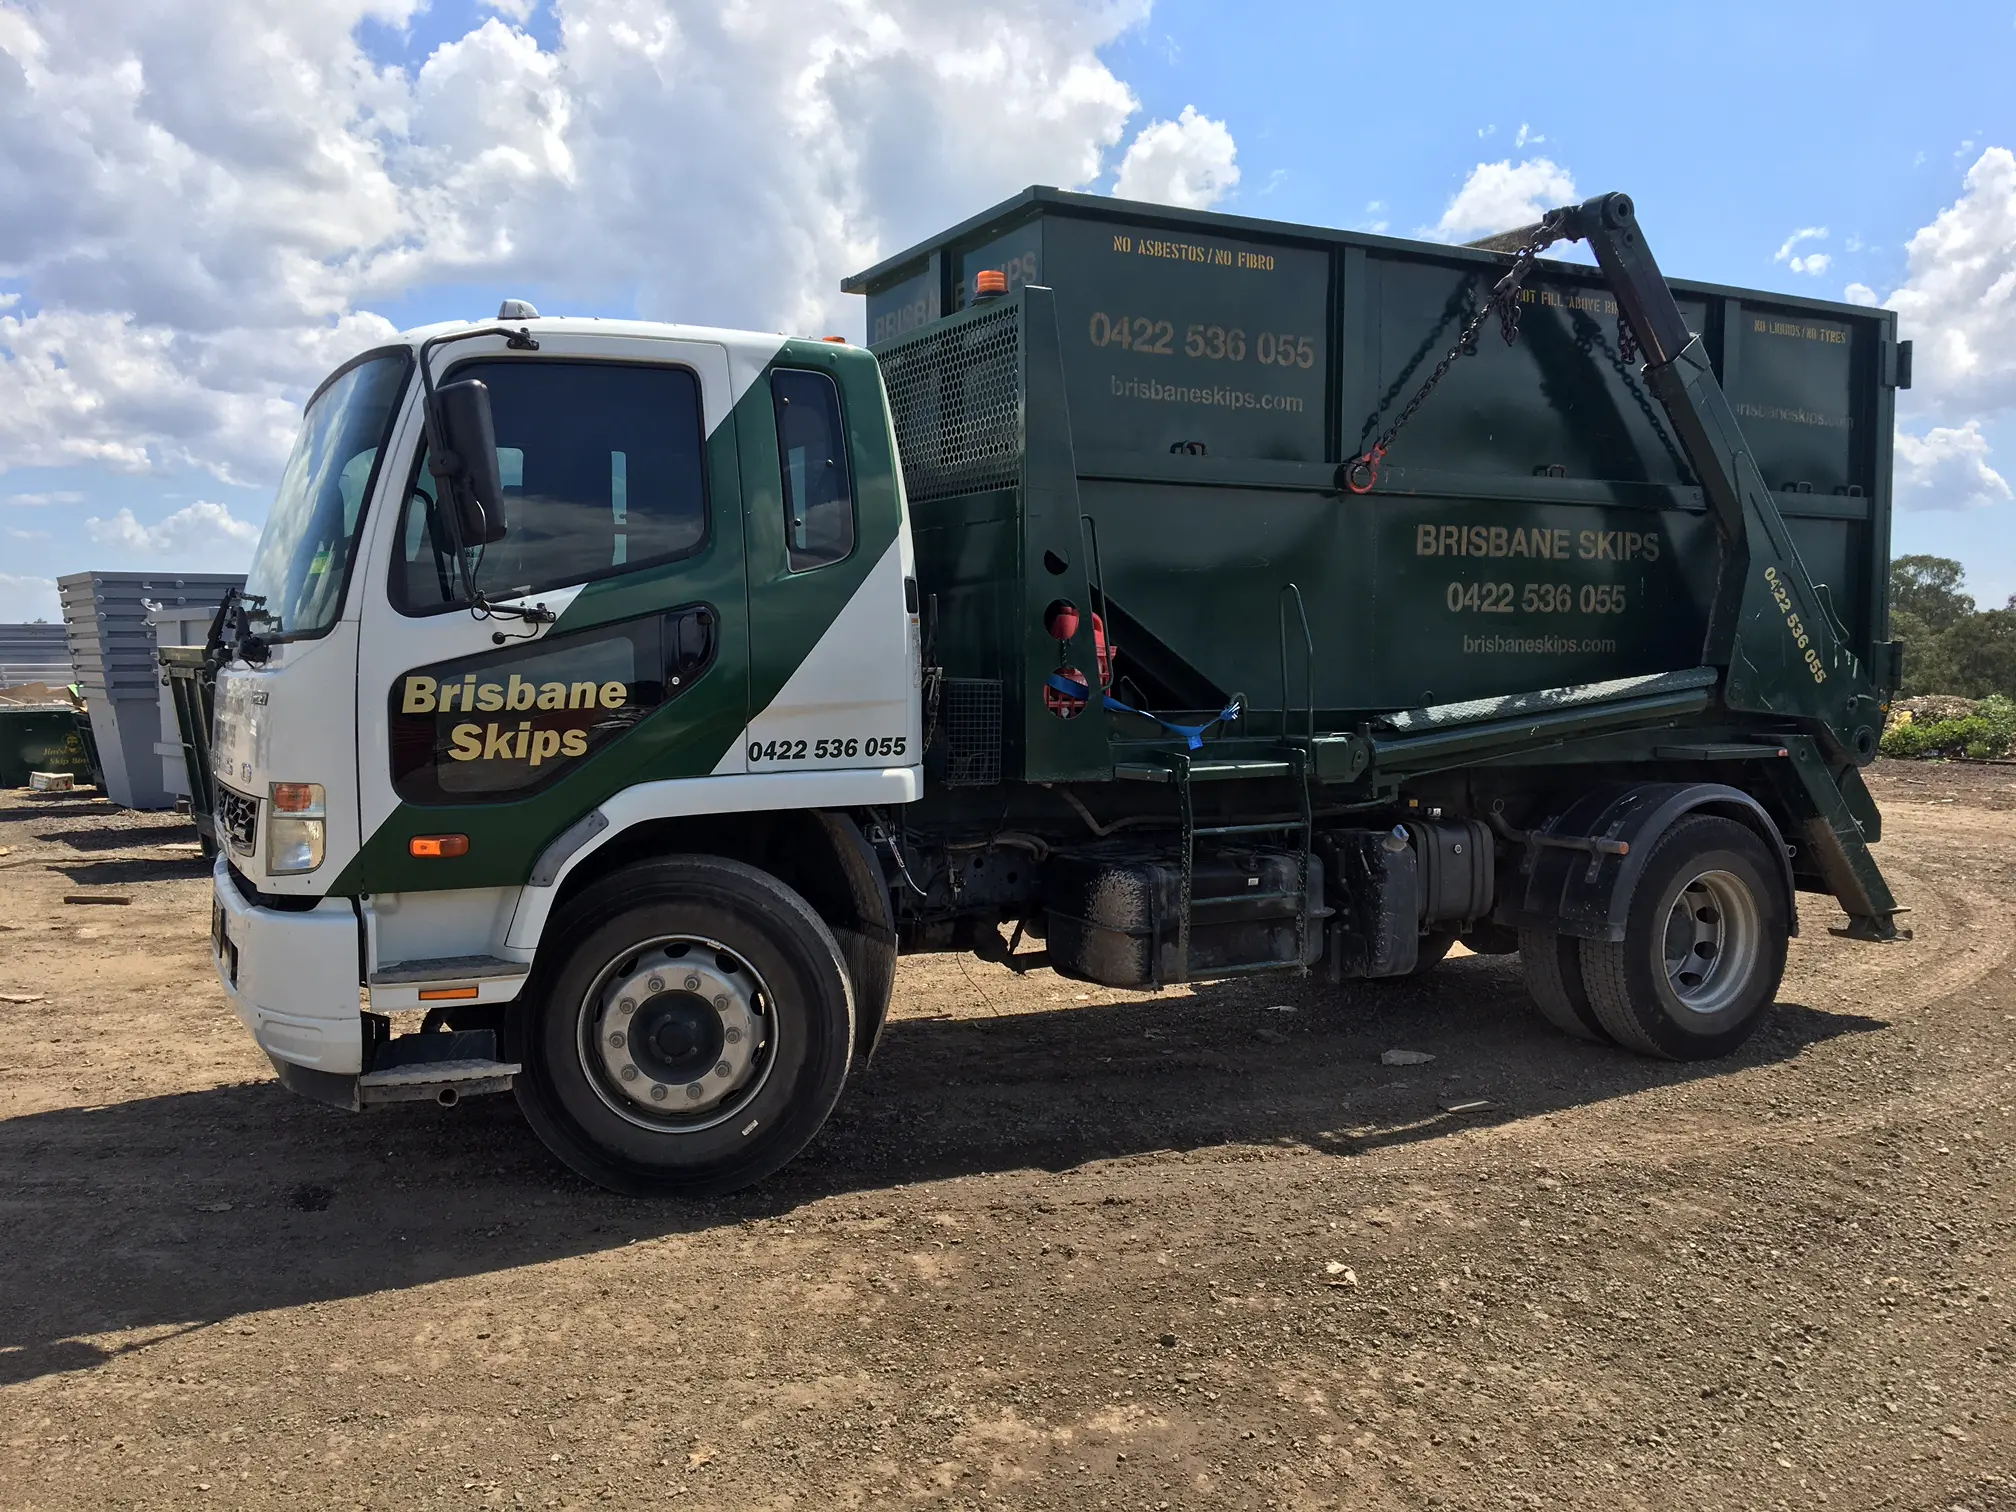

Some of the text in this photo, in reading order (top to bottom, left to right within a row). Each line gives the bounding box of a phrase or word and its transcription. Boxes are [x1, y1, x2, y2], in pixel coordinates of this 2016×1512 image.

[1113, 235, 1131, 252] NO
[1238, 251, 1275, 271] FIBRO
[1518, 289, 1536, 304] OT
[1541, 291, 1563, 307] FILL
[1569, 296, 1600, 312] ABOVE
[1089, 312, 1315, 369] 0422 536 055
[1754, 320, 1766, 333] NO
[1820, 328, 1846, 344] TYRES
[1111, 375, 1303, 412] brisbaneskips.com
[1416, 523, 1660, 562] BRISBANE SKIPS
[1447, 581, 1626, 614] 0422 536 055
[1764, 566, 1828, 684] 0422 536 055
[1463, 635, 1616, 656] brisbaneskips.com
[401, 674, 628, 714] Brisbane
[447, 721, 588, 766] Skips
[748, 737, 907, 762] 0422 536 055
